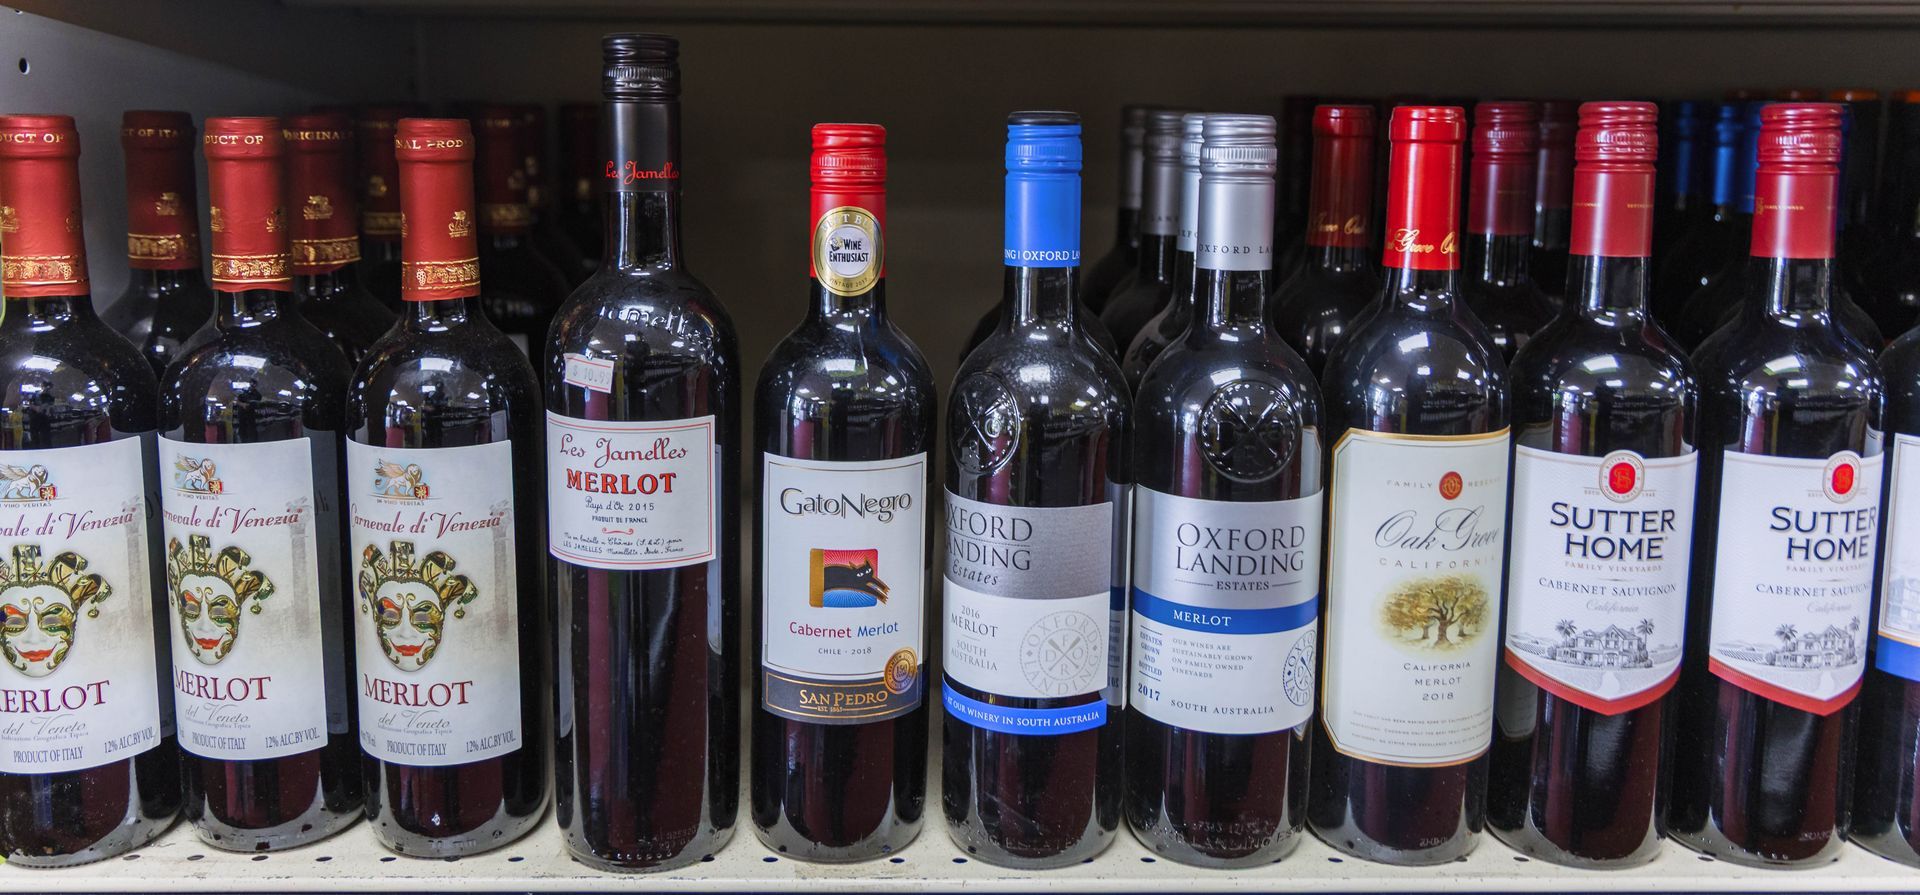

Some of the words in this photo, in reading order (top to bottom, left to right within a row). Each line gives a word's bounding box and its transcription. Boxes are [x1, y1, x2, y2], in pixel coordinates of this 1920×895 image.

[244, 135, 264, 145] OF
[283, 128, 342, 141] ORIGINA
[828, 251, 869, 264] ENTHUSIAST
[1023, 250, 1070, 262] OXFORD
[560, 434, 585, 457] Les
[594, 437, 688, 468] Jamelles
[566, 468, 677, 495] MERLOT
[1387, 480, 1433, 489] FAMILY
[585, 496, 604, 513] Pays
[629, 503, 655, 511] 2015
[780, 487, 912, 524] GatoNegro
[36, 512, 56, 536] di
[58, 508, 133, 540] Venezia
[206, 506, 223, 528] di
[224, 507, 299, 534] Venezia
[351, 503, 405, 533] Carnevale
[409, 511, 427, 534] di
[429, 511, 501, 540] Venezia
[1551, 502, 1675, 534] SUTTER
[1770, 506, 1877, 534] SUTTER
[1177, 522, 1305, 551] OXFORD
[1374, 509, 1443, 550] Oak
[574, 544, 602, 553] JAMELLES
[946, 531, 1031, 571] ANDING
[1566, 533, 1664, 560] HOME
[1787, 534, 1870, 562] HOME
[1175, 546, 1304, 576] LANDING
[1566, 561, 1602, 571] FAMILY
[952, 558, 998, 586] Estates
[1216, 580, 1270, 591] ESTATES
[1539, 578, 1606, 595] CABERNET
[1612, 584, 1676, 596] SAUVIGNON
[1756, 584, 1826, 597] CABERNET
[961, 605, 980, 619] 2016
[1173, 609, 1232, 626] MERLOT
[789, 621, 851, 638] Cabernet
[857, 621, 899, 637] Merlot
[951, 612, 998, 638] MERLOT
[818, 647, 841, 655] CHILE
[851, 647, 872, 655] 2018
[957, 639, 987, 657] SOUTH
[1172, 638, 1187, 646] OUR
[1190, 641, 1214, 649] WINES
[951, 649, 998, 671] AUSTRALIA
[1172, 648, 1221, 660] SUSTAINABLY
[1224, 653, 1253, 661] GROWN
[1171, 666, 1213, 678] VINEYARDS
[1184, 659, 1213, 670] FAMILY
[1403, 662, 1471, 671] CALIFORNIA
[175, 665, 271, 702] MERLOT
[364, 673, 473, 707] MERLOT
[1415, 677, 1462, 686] MERLOT
[0, 680, 110, 714] ERLOT
[800, 689, 831, 705] SAN
[834, 690, 888, 706] PEDRO
[1138, 682, 1161, 702] 2017
[1422, 693, 1454, 701] 2018
[203, 702, 249, 724] Veneto
[967, 706, 999, 724] WINERY
[1002, 715, 1014, 725] IN
[1017, 717, 1050, 726] SOUTH
[1054, 711, 1100, 726] AUSTRALIA
[1170, 699, 1208, 713] SOUTH
[1213, 705, 1275, 715] AUSTRALIA
[2, 722, 24, 736] del
[30, 713, 86, 736] Veneto
[378, 713, 396, 726] del
[401, 709, 450, 729] Veneto
[104, 740, 119, 754] 12%
[192, 732, 216, 749] PRODUCT
[218, 737, 226, 750] OF
[227, 737, 246, 750] ITALY
[265, 736, 280, 749] 12%
[386, 740, 416, 756] PRODUCT
[418, 742, 427, 756] OF
[427, 742, 447, 756] ITALY
[466, 740, 479, 753] 12%
[13, 750, 48, 764] PRODUCT
[50, 749, 61, 763] OF
[62, 746, 83, 760] ITALY
